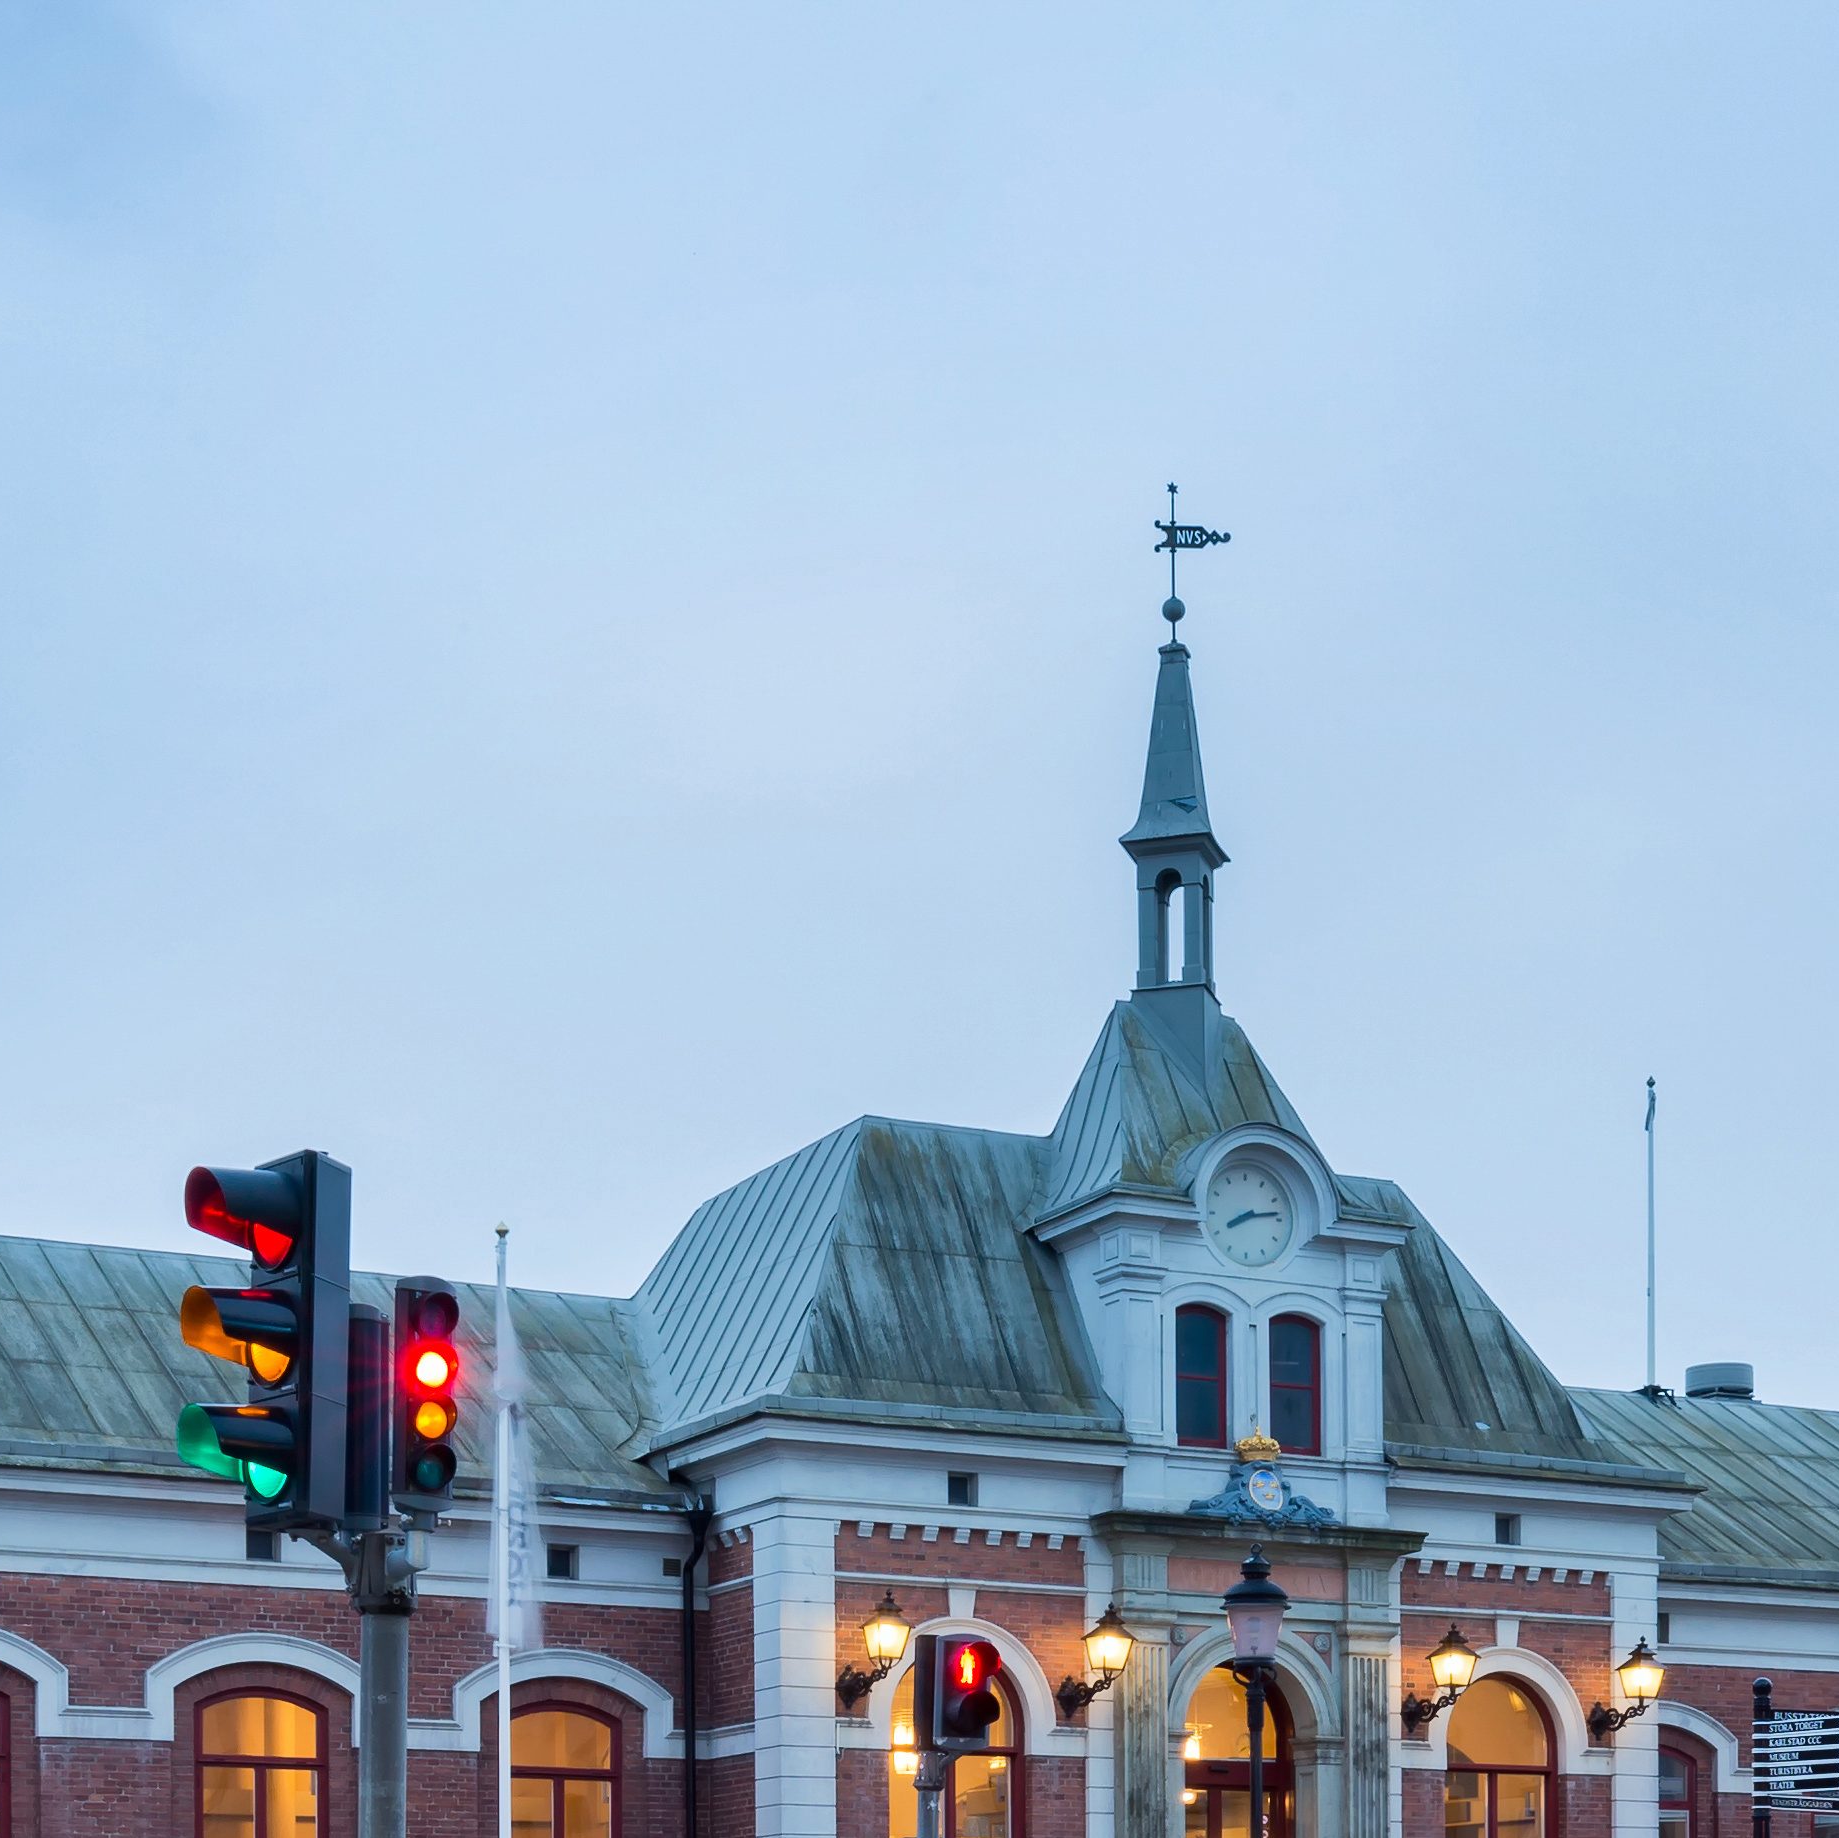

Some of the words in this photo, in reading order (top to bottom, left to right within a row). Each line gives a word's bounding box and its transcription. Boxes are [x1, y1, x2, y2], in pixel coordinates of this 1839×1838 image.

[1769, 1723, 1793, 1733] STORA
[1795, 1721, 1824, 1731] TORGET
[1769, 1738, 1805, 1747] KARLSTAD
[1807, 1736, 1822, 1745] CCC
[1769, 1752, 1799, 1761] MUSEUM
[1769, 1781, 1796, 1790] TEATER
